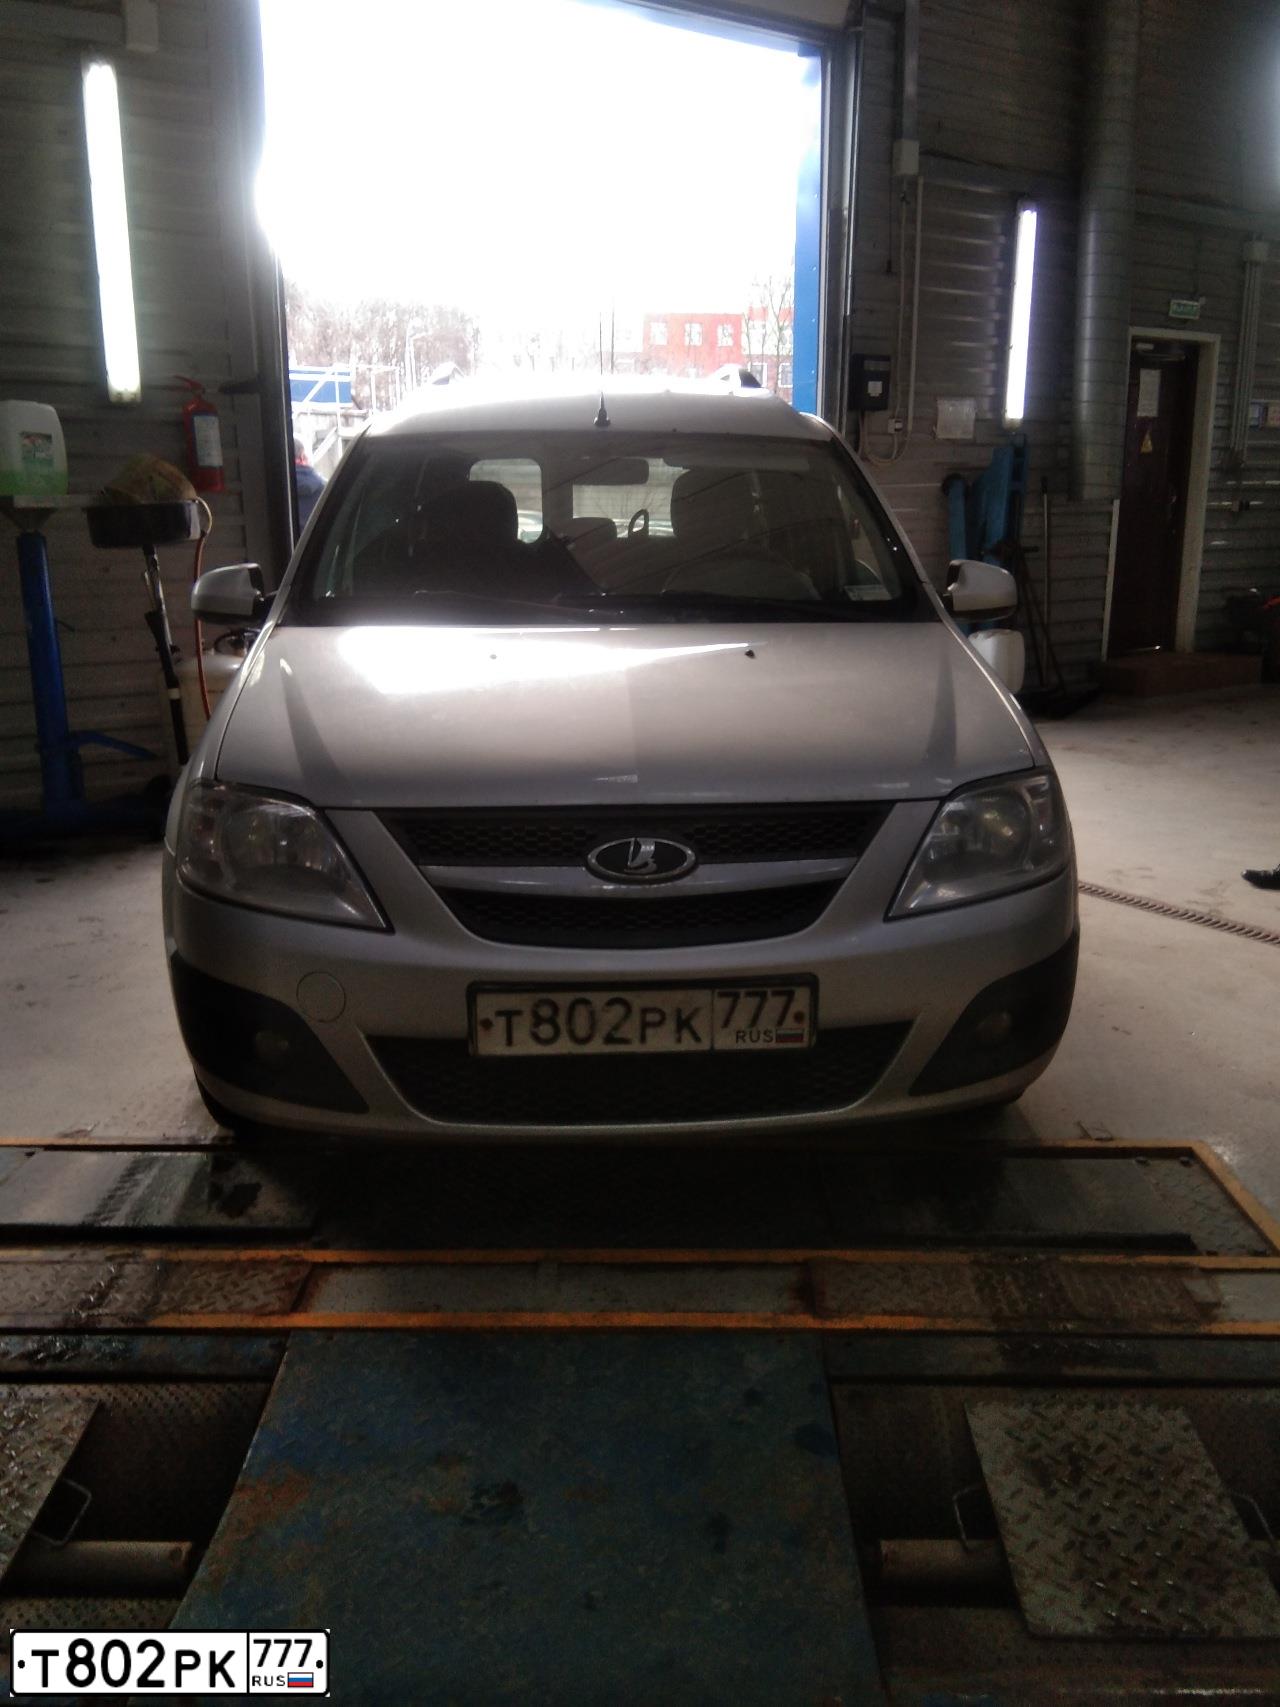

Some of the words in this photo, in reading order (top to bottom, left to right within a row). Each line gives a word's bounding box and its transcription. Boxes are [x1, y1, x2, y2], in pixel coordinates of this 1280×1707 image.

[495, 996, 704, 1047] T802PK
[717, 989, 796, 1029] 777
[735, 1029, 774, 1044] RUS
